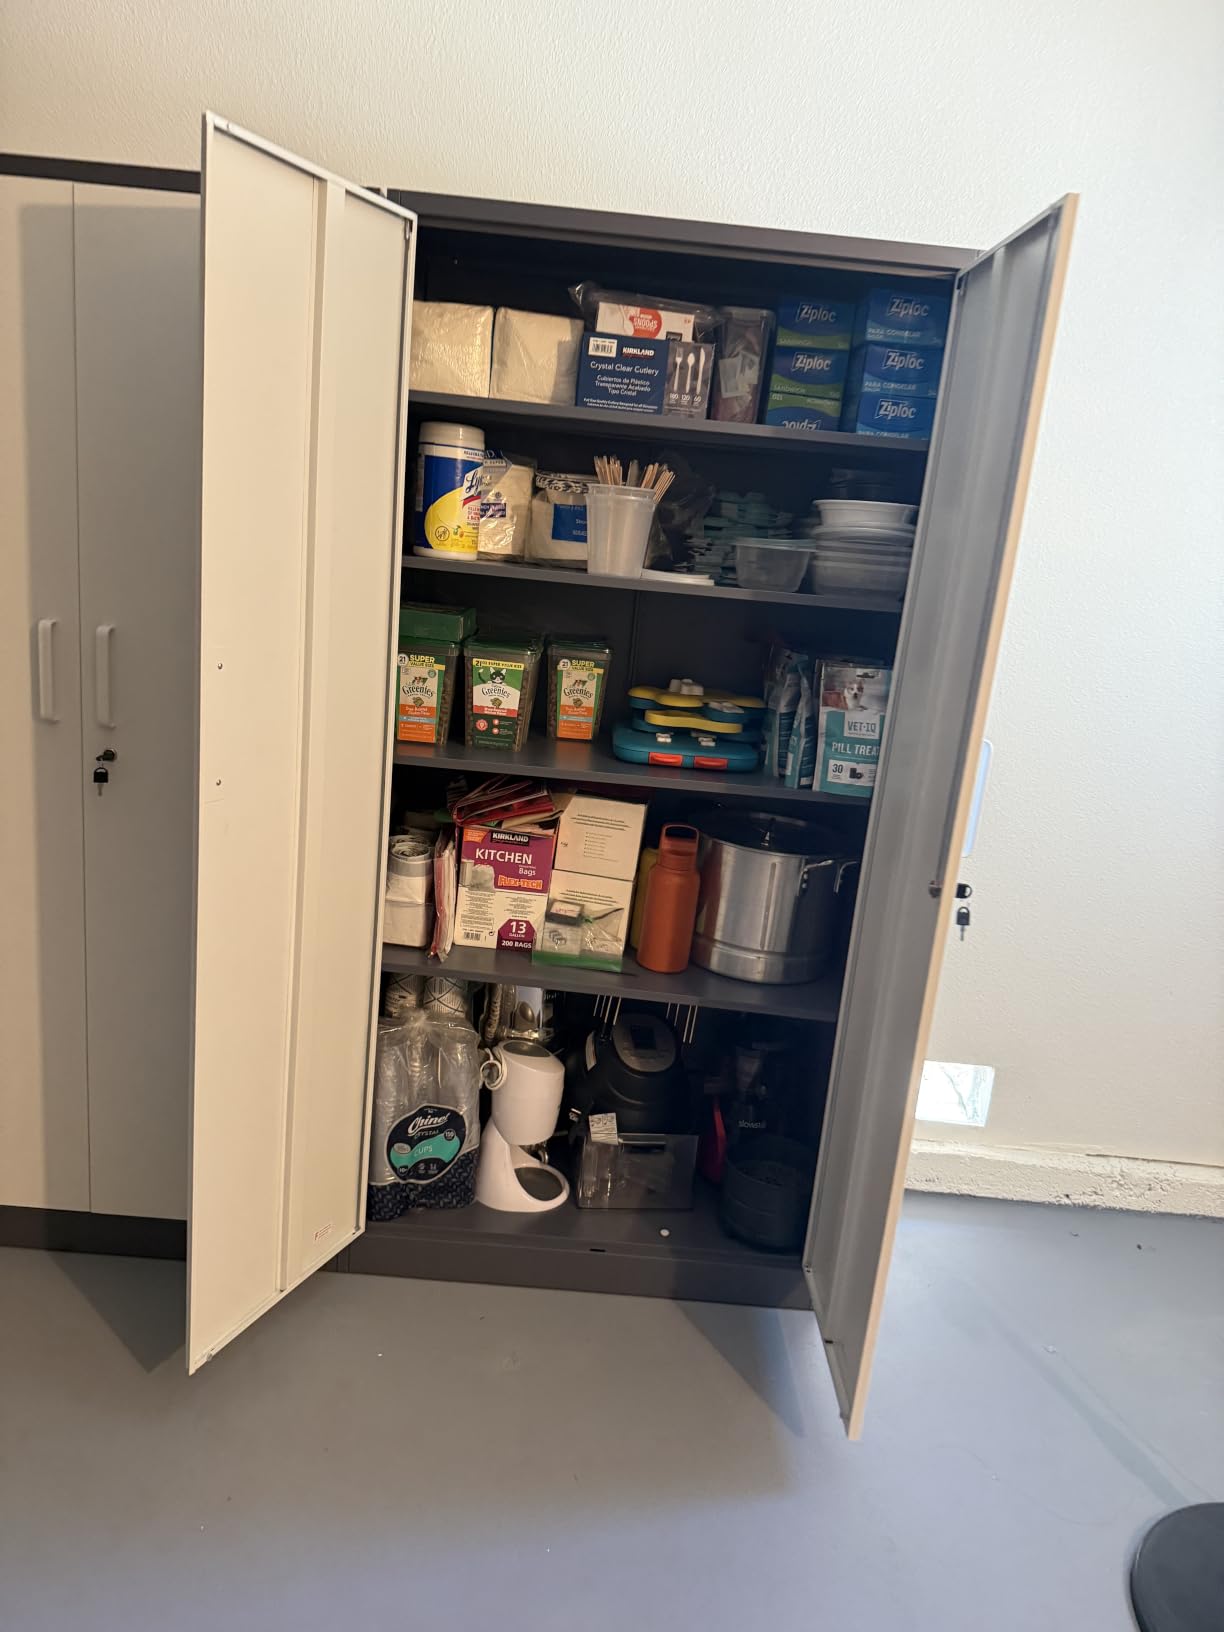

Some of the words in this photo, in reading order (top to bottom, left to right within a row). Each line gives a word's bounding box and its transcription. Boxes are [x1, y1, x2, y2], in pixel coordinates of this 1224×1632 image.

[800, 304, 837, 323] Ziploc
[890, 297, 930, 318] Ziploc
[622, 347, 655, 357] KIRKLAND
[795, 354, 832, 373] Ziploc
[887, 351, 925, 370] Ziploc
[590, 361, 614, 371] Crystal
[615, 363, 634, 372] Clear
[634, 366, 659, 377] Cutlery
[596, 374, 622, 383] Cubiertos
[879, 401, 917, 420] Ziploc
[399, 656, 406, 664] 21
[409, 654, 435, 663] SUPER
[572, 659, 595, 667] SUPER
[402, 684, 434, 698] Greenies
[481, 687, 511, 699] Greenies
[563, 687, 593, 699] Greenies
[832, 742, 851, 754] PILL
[832, 763, 844, 774] 30
[492, 832, 529, 842] KIRKLAND
[475, 848, 533, 865] KITCHEN
[518, 867, 537, 877] Bags
[498, 874, 543, 890] FLEX-TECH
[510, 921, 527, 934] 13
[514, 941, 532, 949] BAGS
[414, 1145, 433, 1157] CUPS
